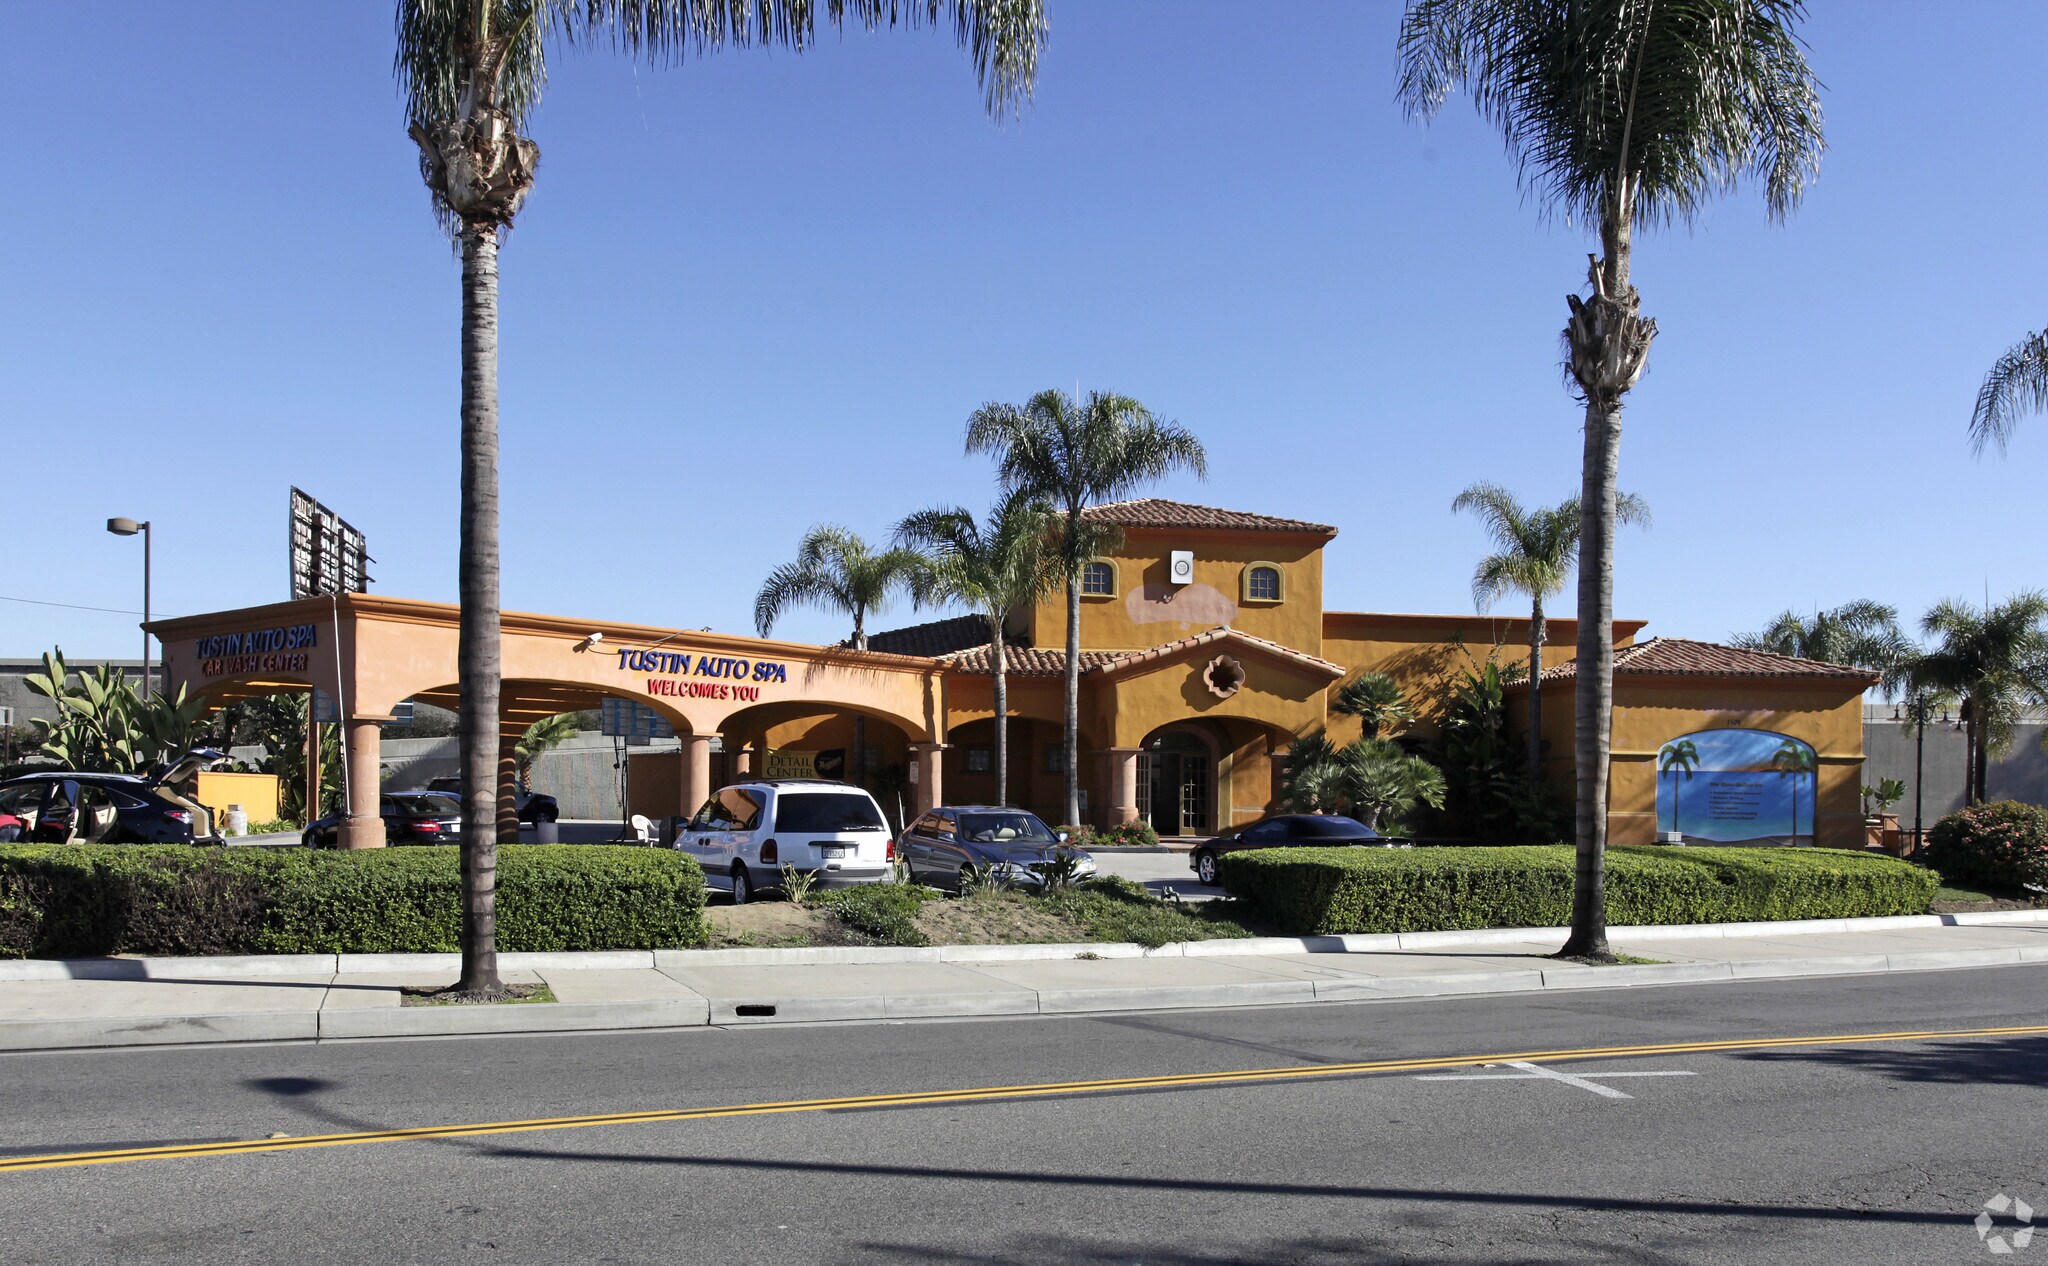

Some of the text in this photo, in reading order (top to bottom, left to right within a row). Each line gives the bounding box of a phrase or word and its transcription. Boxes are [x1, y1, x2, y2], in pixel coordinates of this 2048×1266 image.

[195, 624, 317, 658] TUSTIN AUTO SPA
[261, 653, 309, 673] CENTER
[618, 649, 787, 683] TUSTIN AUTO SPA
[648, 678, 760, 702] WELCOMES YOU
[770, 755, 811, 766] DETAIL
[766, 766, 814, 778] CENTER
